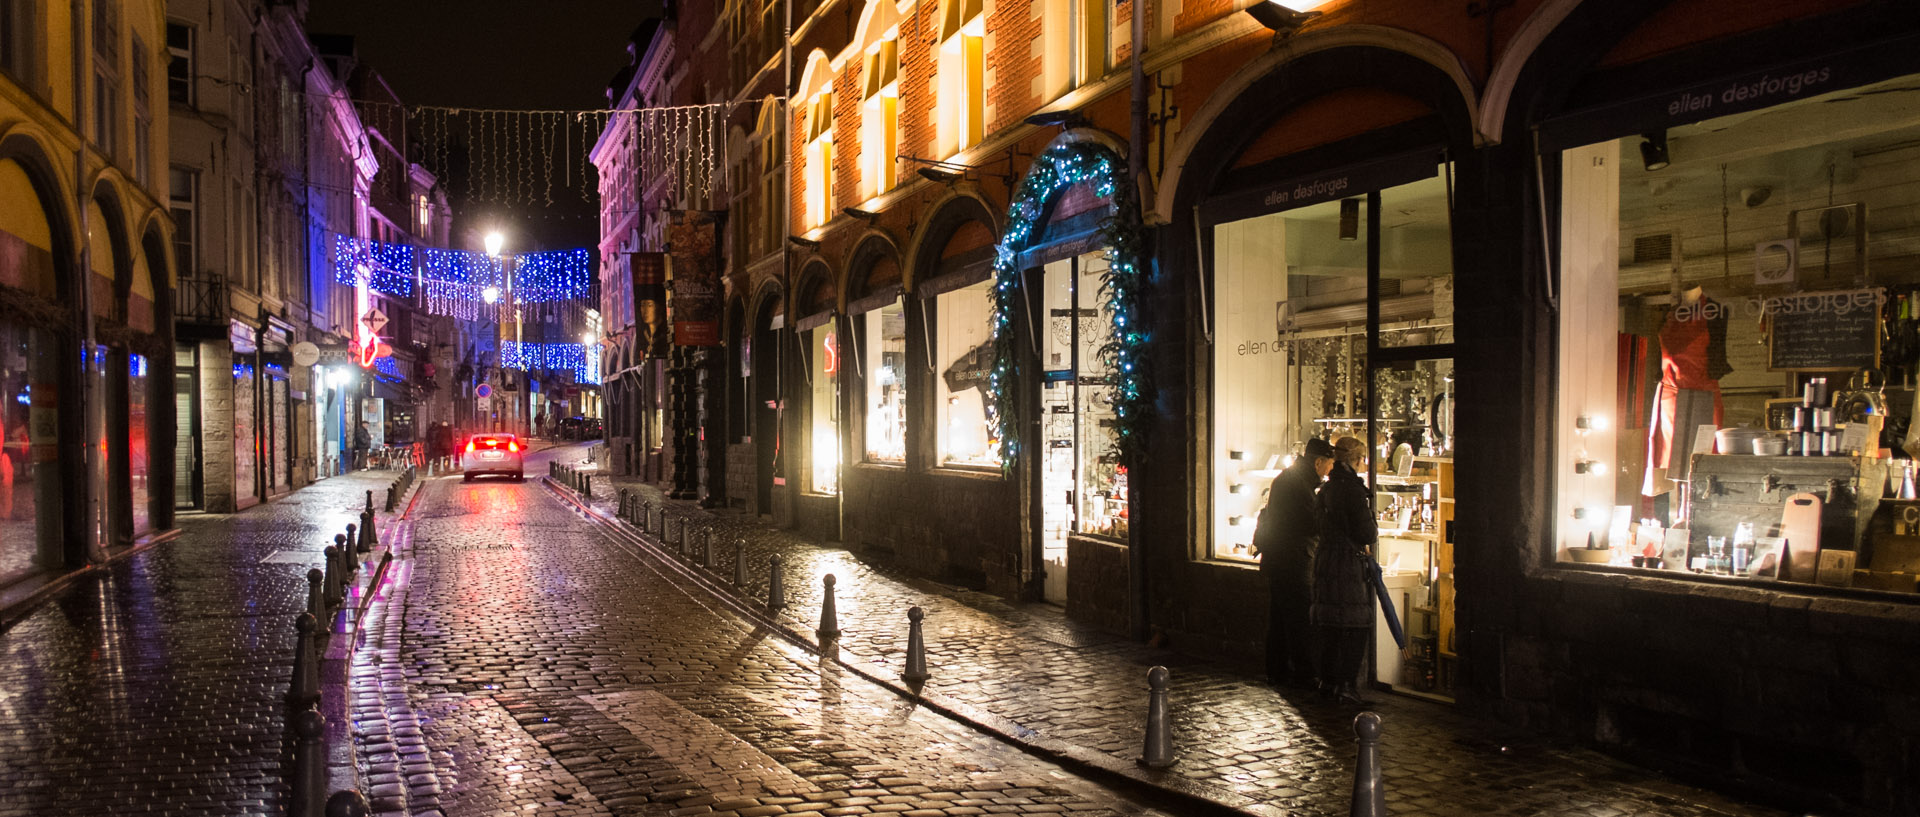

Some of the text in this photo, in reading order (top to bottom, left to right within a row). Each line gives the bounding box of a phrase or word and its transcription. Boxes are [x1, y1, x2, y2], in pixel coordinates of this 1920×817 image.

[1667, 67, 1830, 116] ellen desforges
[1264, 177, 1349, 206] ellen desforges
[1675, 288, 1888, 323] ellen desforges
[1238, 340, 1268, 356] ellen
